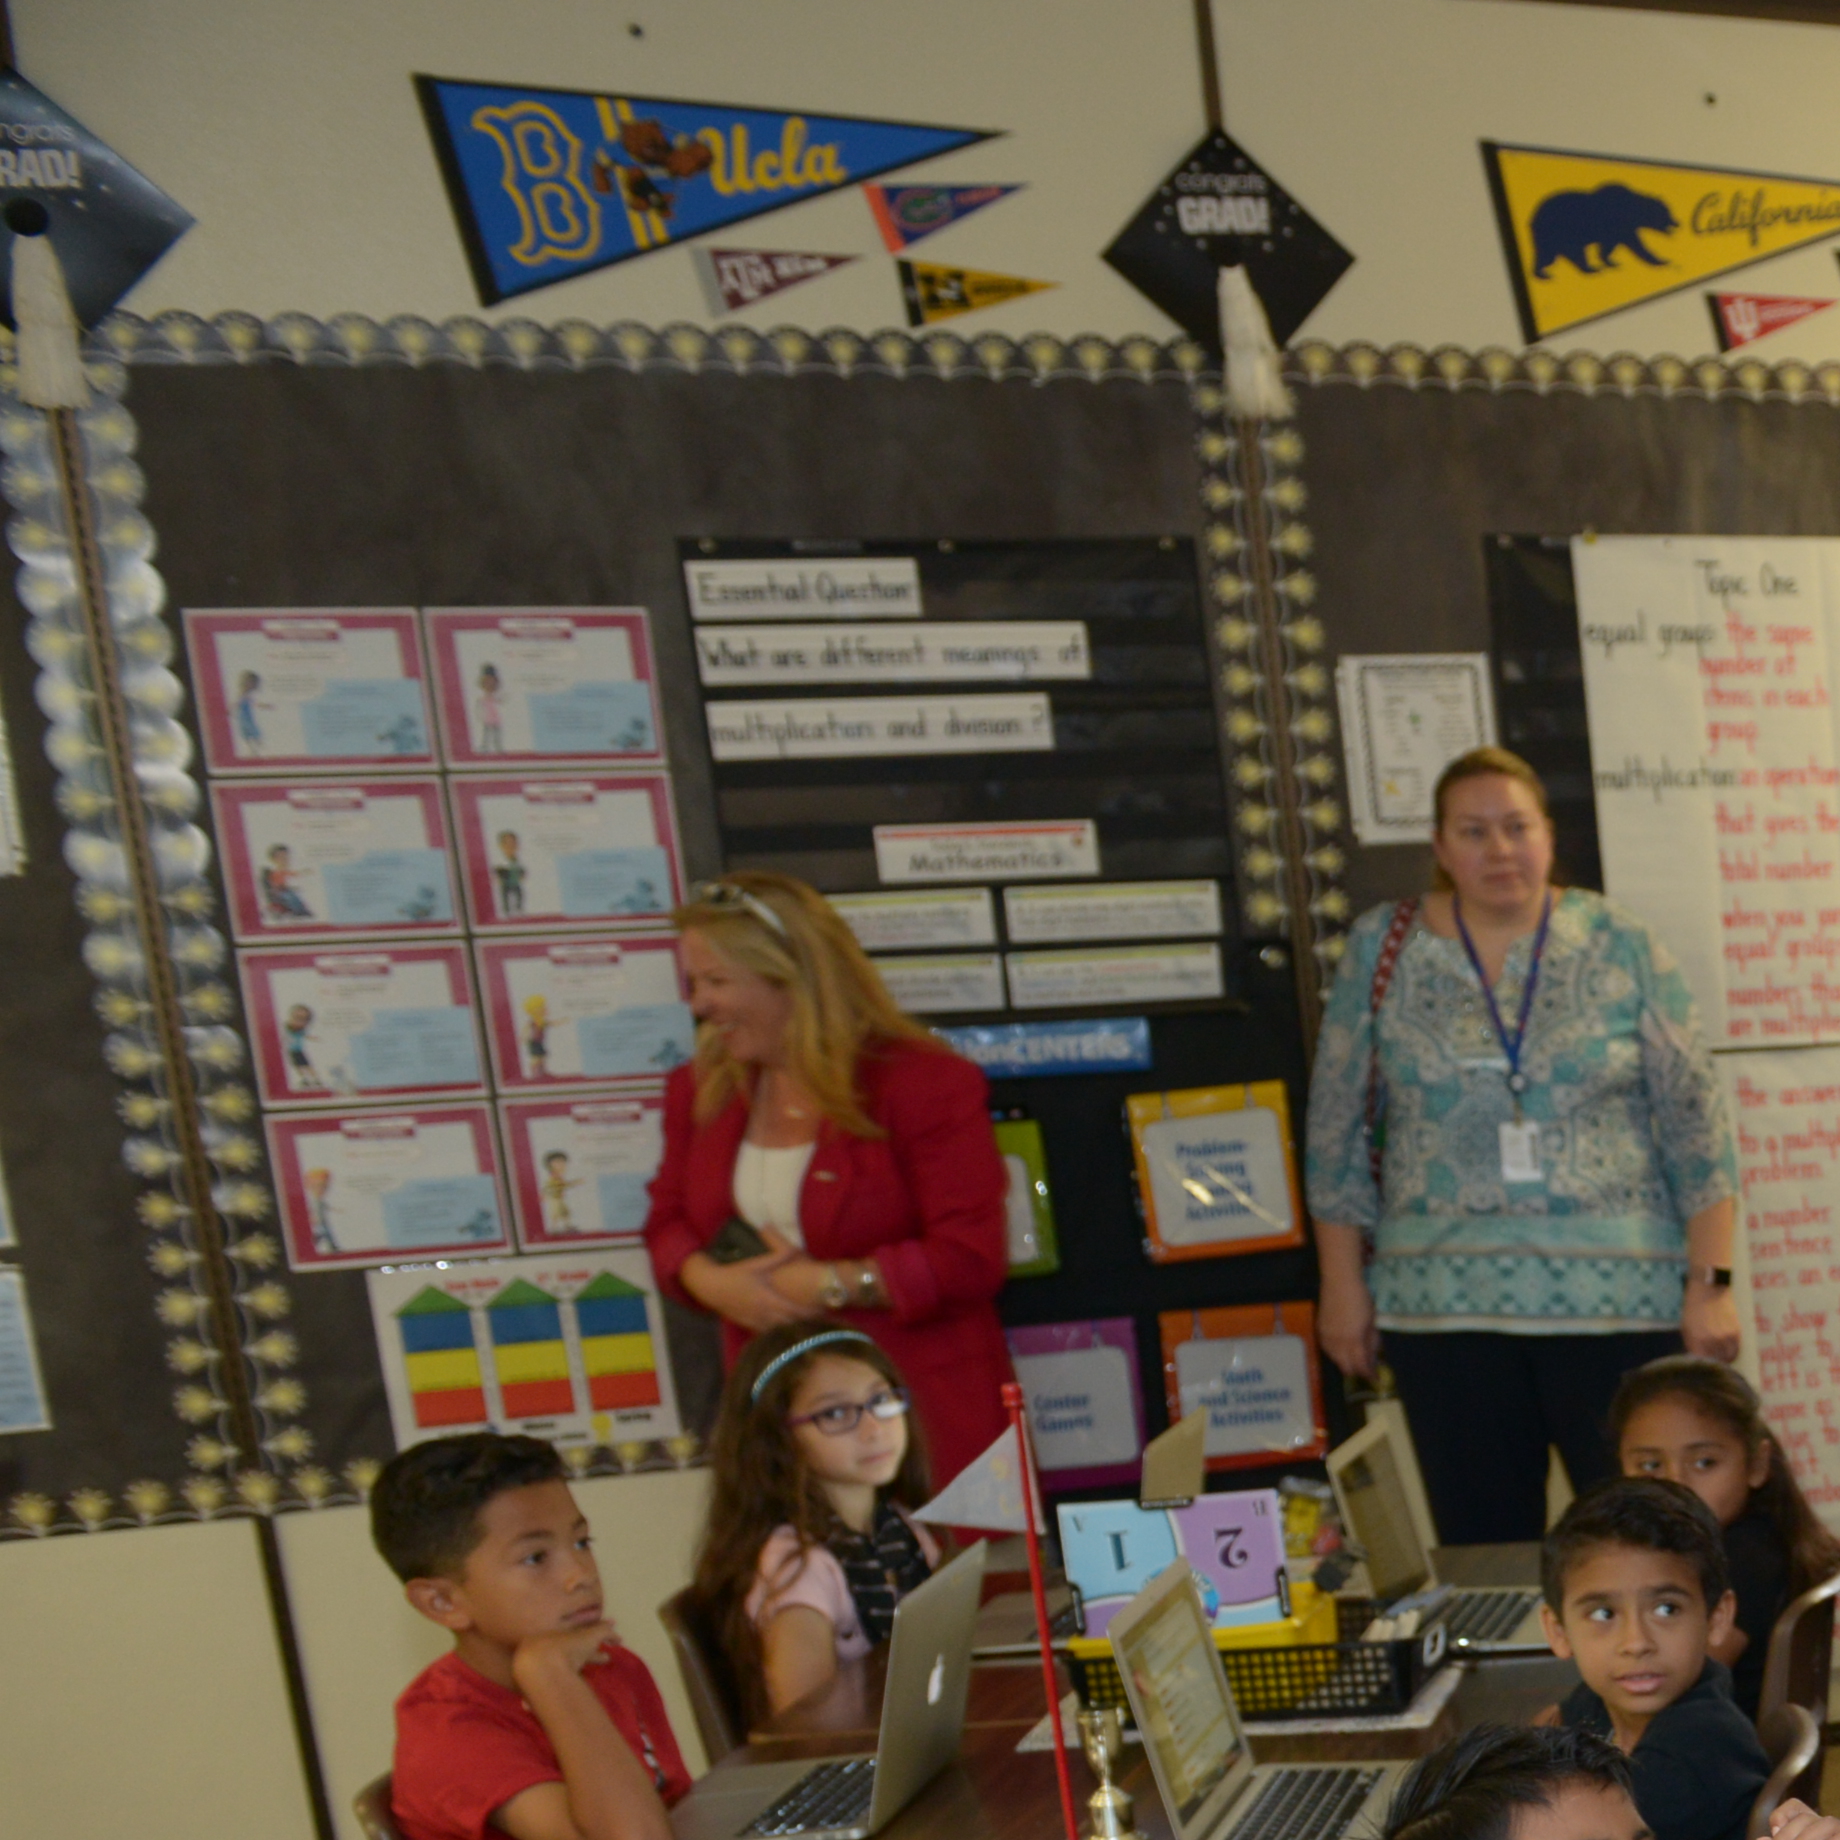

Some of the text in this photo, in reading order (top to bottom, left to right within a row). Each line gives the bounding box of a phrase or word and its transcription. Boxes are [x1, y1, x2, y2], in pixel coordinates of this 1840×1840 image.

[700, 116, 848, 196] Ucla
[472, 100, 599, 266] B
[1175, 173, 1267, 194] congrats
[1177, 196, 1271, 235] GRAD!
[697, 571, 910, 605] Essential Question
[1695, 559, 1798, 610] Topic One
[701, 632, 1083, 677] What are different meanings of
[711, 712, 873, 757] multiplication
[887, 708, 927, 737] and
[943, 706, 1020, 736] division
[908, 849, 1064, 875] Mathematics
